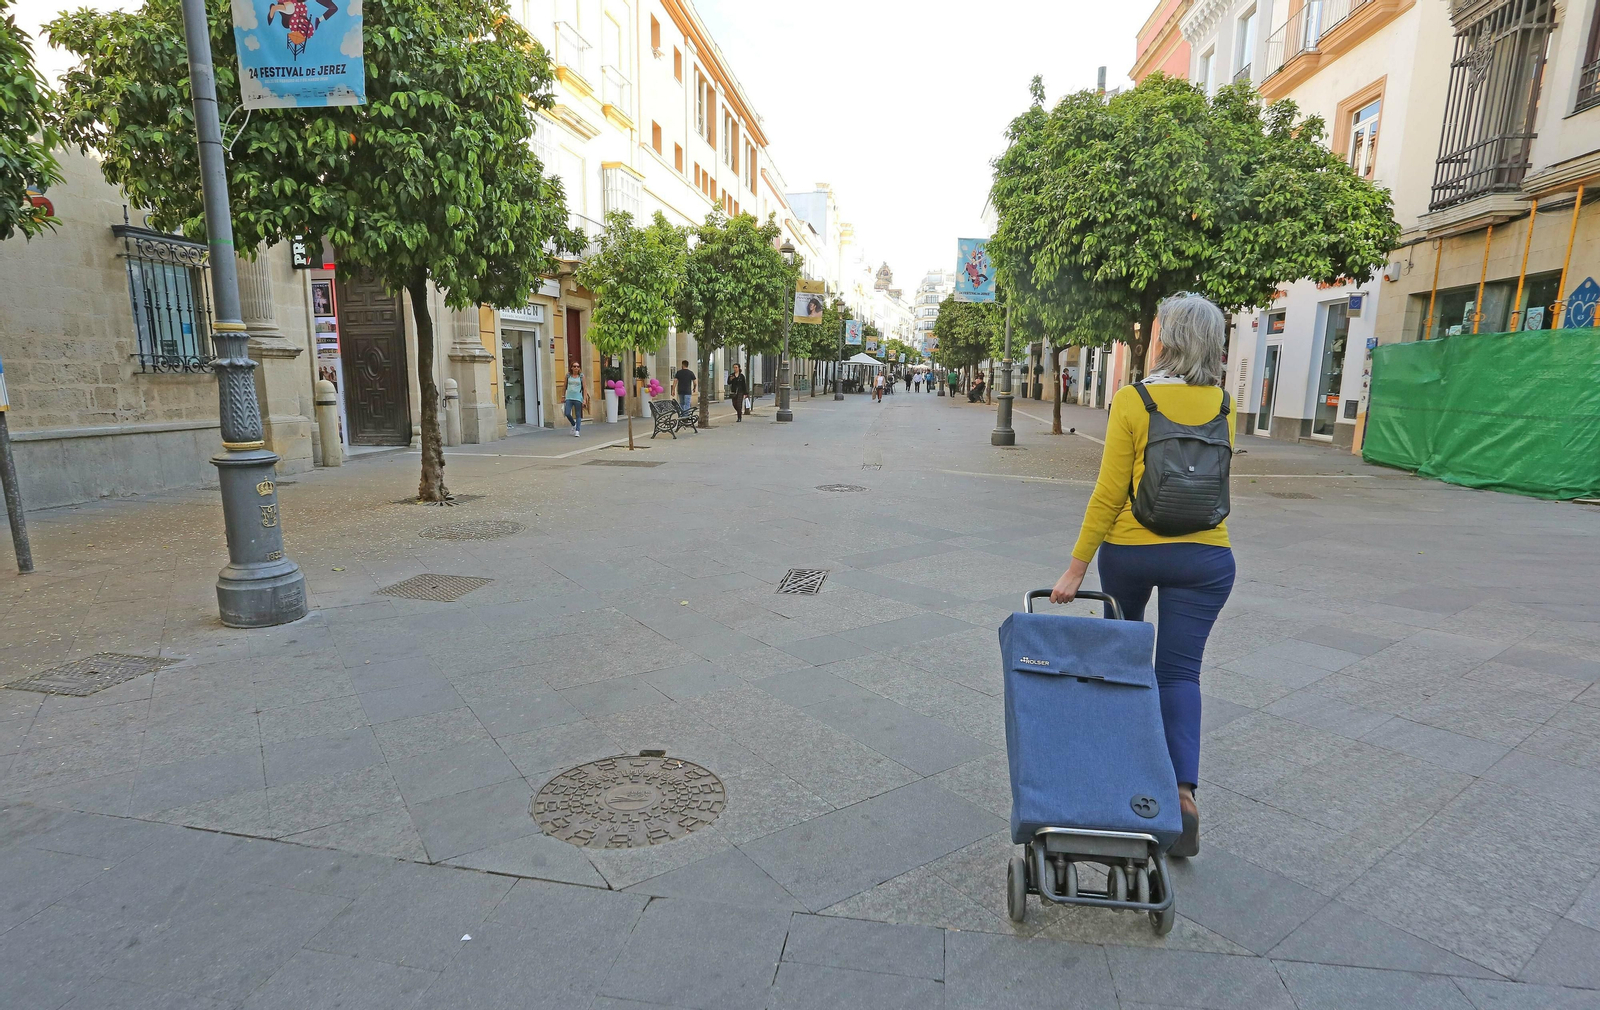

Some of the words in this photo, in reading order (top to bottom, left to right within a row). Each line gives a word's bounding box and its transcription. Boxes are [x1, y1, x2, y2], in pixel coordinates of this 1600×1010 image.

[249, 68, 258, 79] 24
[260, 66, 303, 78] FESTIVAL
[306, 68, 316, 76] DE
[317, 64, 347, 76] JEREZ
